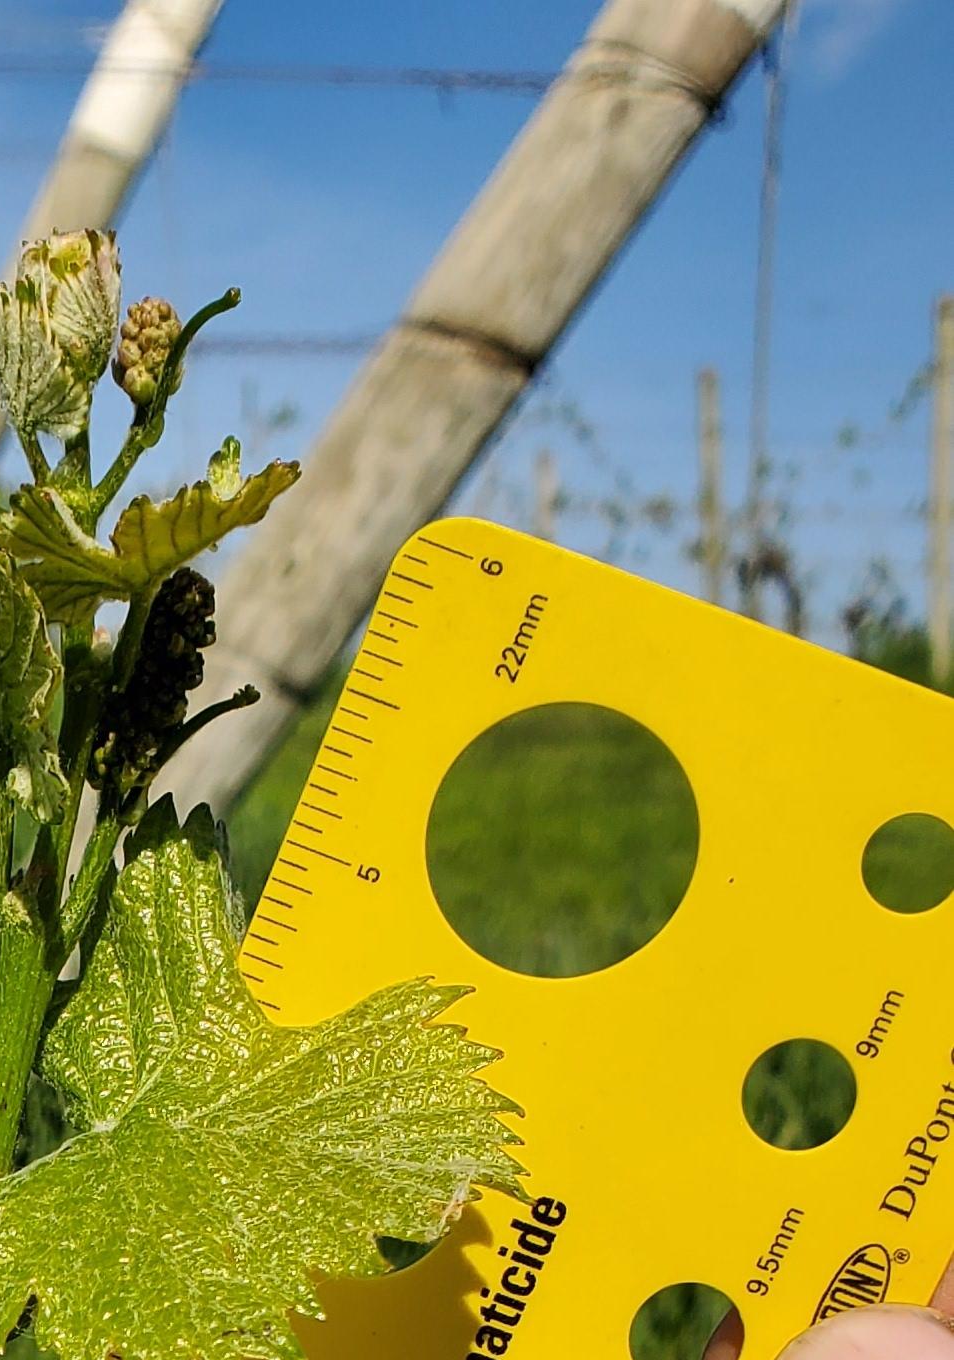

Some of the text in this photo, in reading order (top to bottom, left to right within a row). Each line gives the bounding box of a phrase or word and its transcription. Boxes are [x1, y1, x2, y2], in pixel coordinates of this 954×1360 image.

[481, 558, 503, 575] 6
[495, 595, 548, 683] 22mm
[357, 865, 380, 882] 5
[856, 991, 904, 1058] 9mm
[879, 1083, 954, 1220] DuPont
[747, 1208, 804, 1296] 9.5mm
